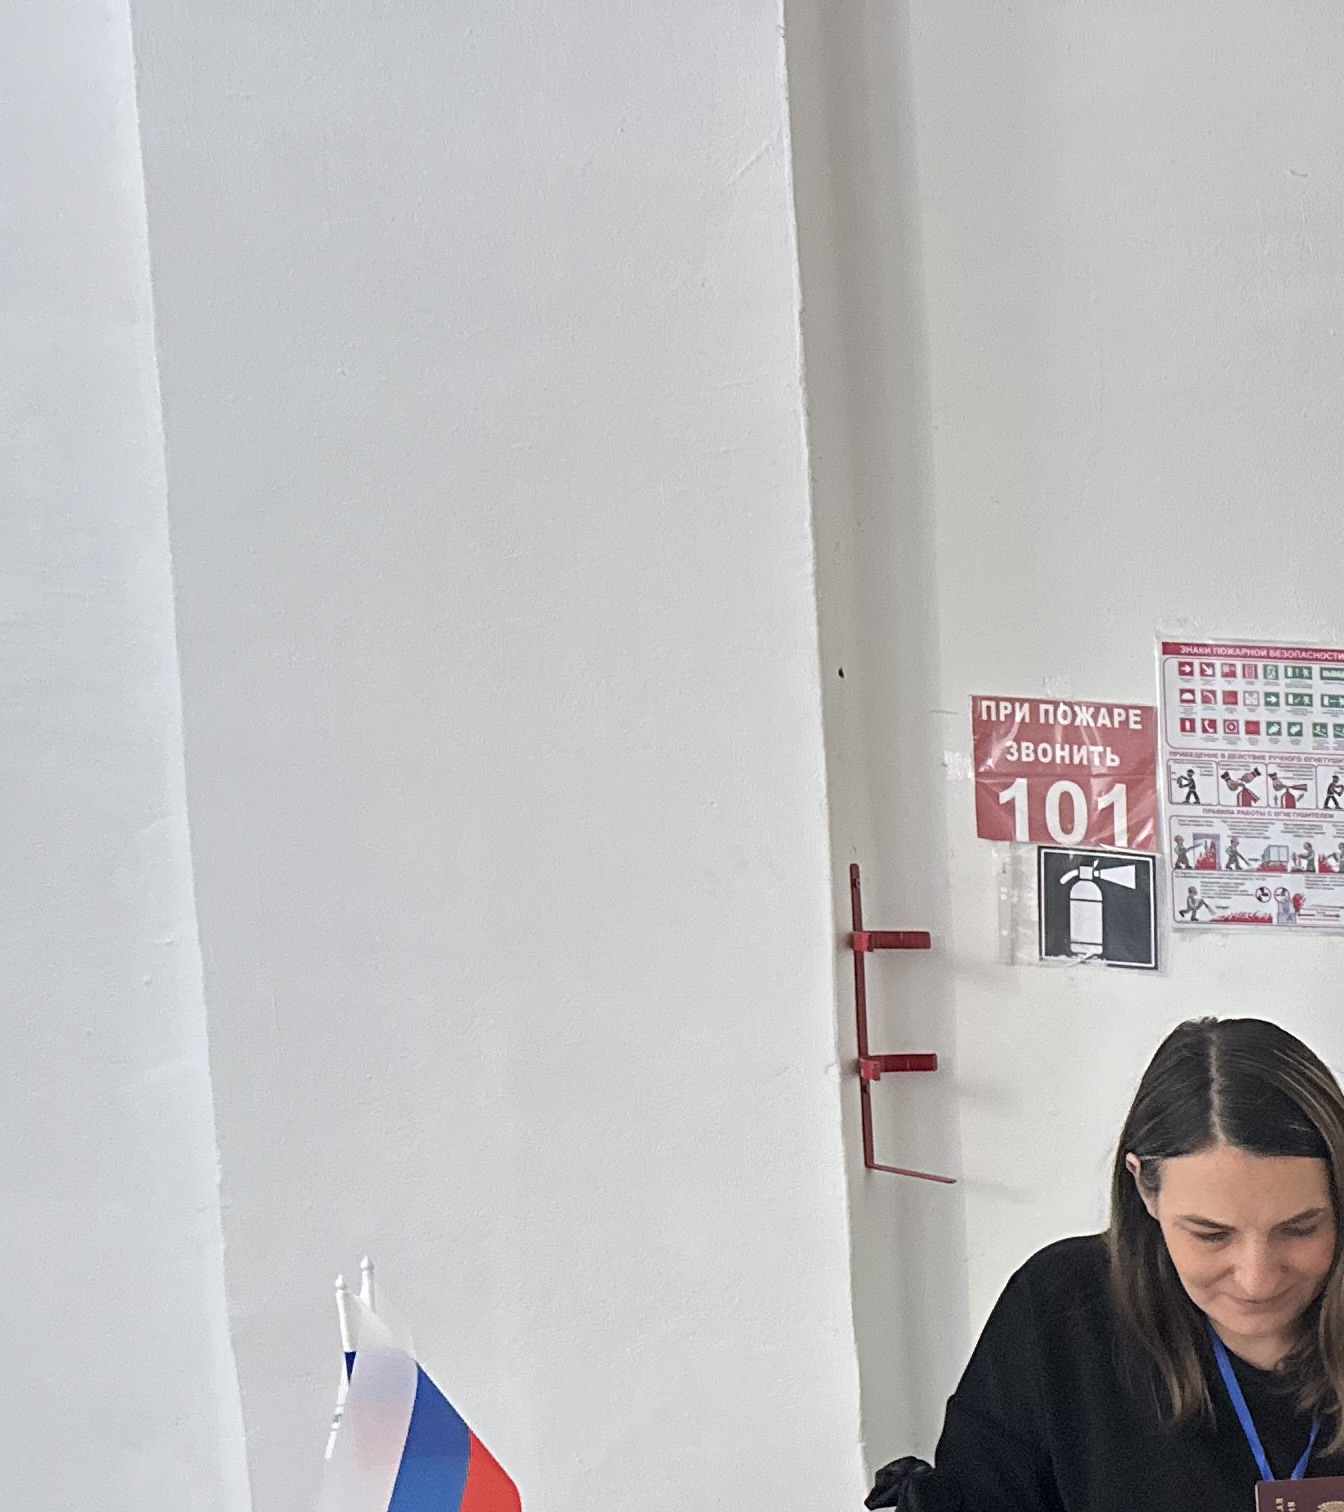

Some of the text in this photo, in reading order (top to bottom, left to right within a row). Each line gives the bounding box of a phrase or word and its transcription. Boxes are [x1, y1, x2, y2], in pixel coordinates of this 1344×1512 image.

[1179, 646, 1344, 660] ЗНАКИ ПОЖАРНОЙ БЕЗОПАСНОСТИ
[981, 700, 1143, 729] ПРИ ПОЖАРЕ
[1005, 740, 1121, 767] ЗВОНИТЬ
[999, 777, 1128, 848] 101
